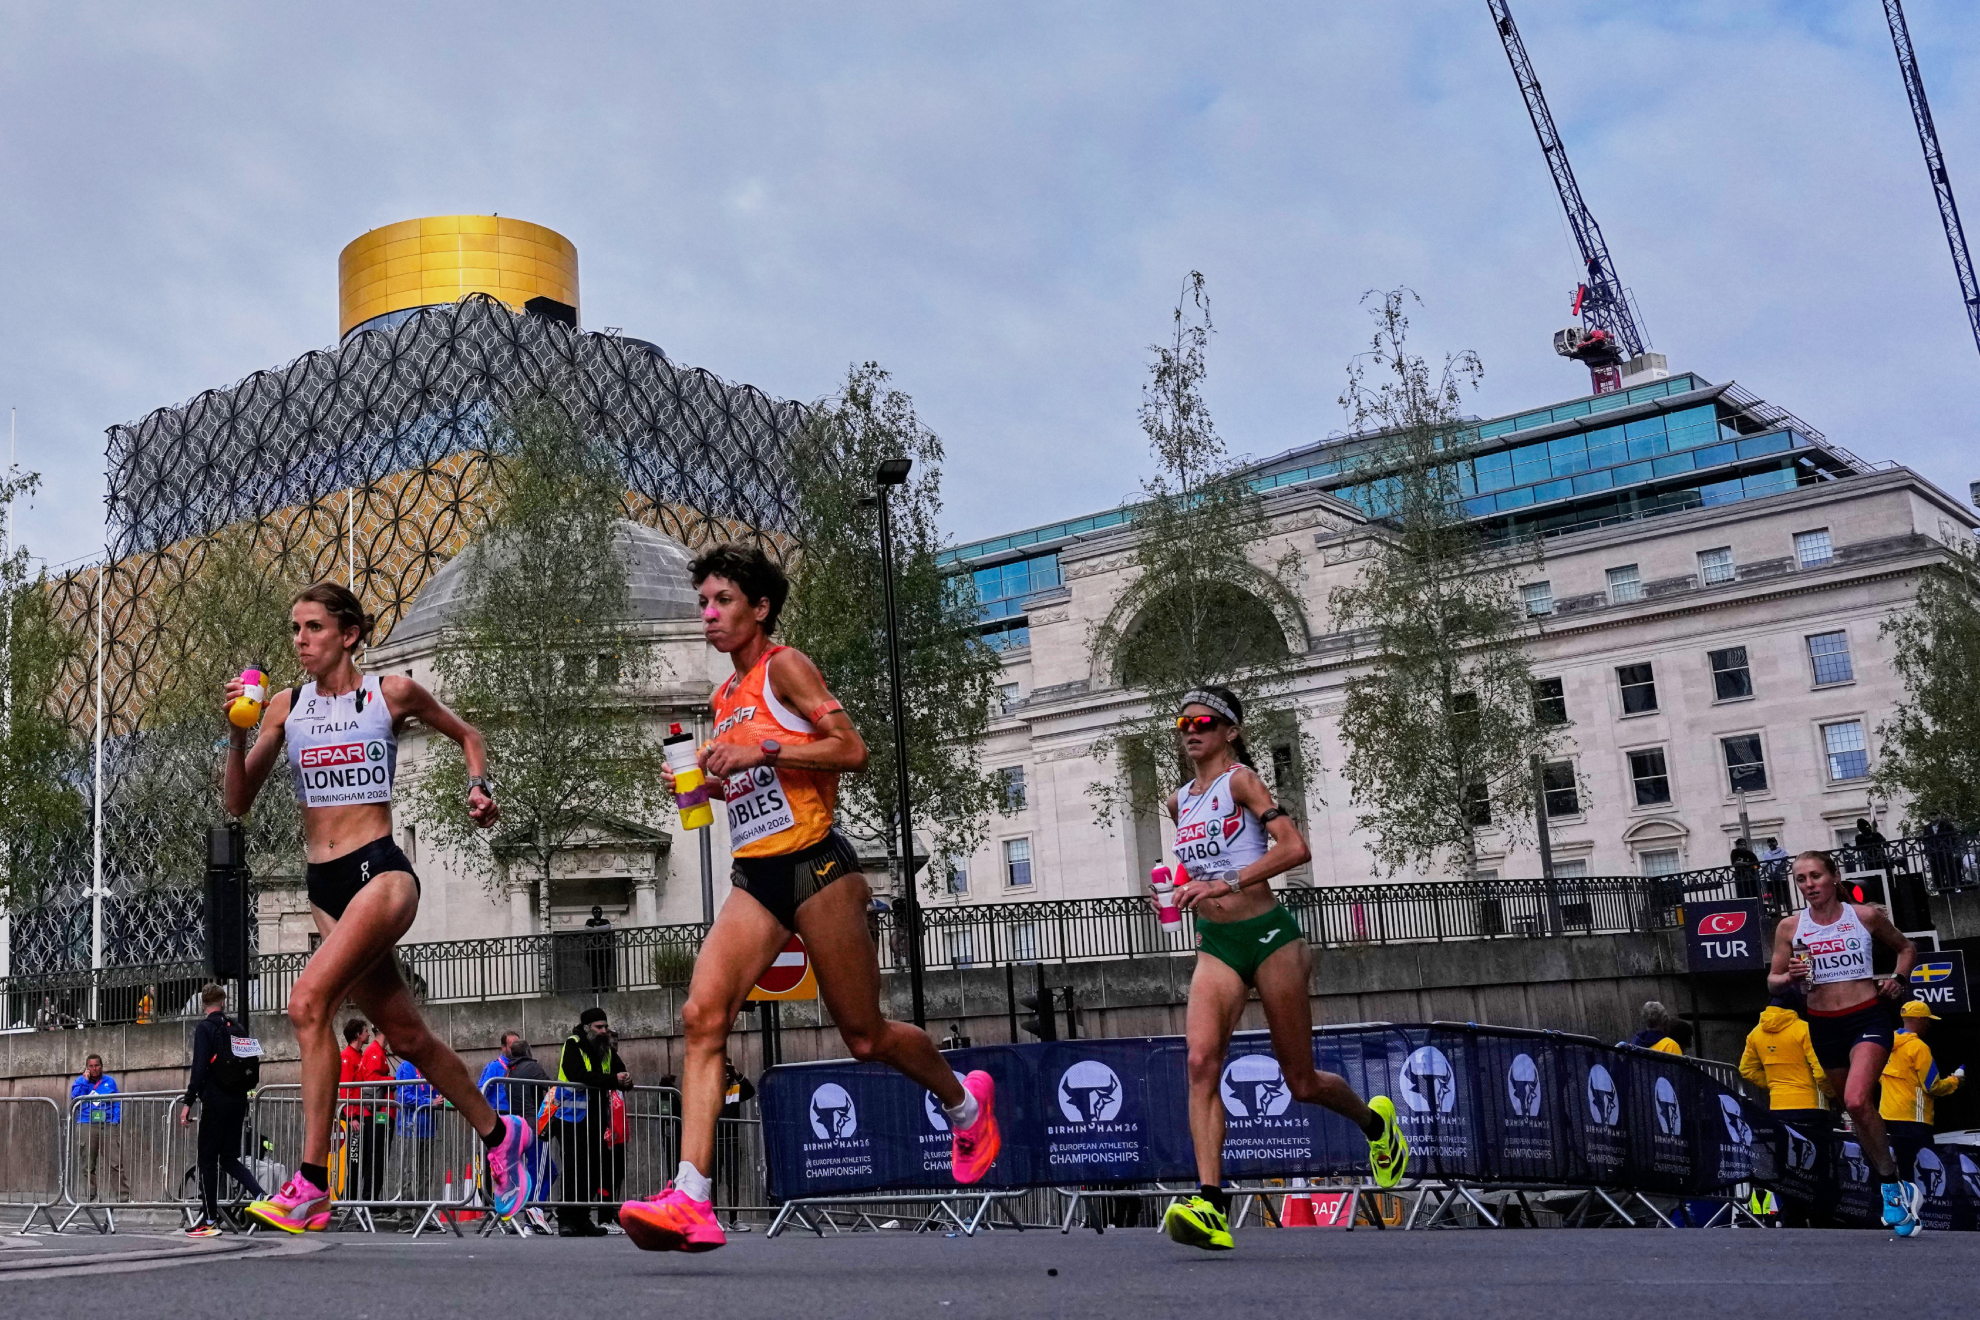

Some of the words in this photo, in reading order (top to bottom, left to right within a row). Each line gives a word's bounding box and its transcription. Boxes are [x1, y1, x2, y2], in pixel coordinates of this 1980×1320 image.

[311, 720, 359, 735] ITALIA
[303, 745, 364, 766] SPAR
[304, 765, 386, 790] LONEDO
[722, 773, 753, 798] PAR
[310, 791, 366, 803] BIRMINGHAM
[367, 789, 388, 799] 2026
[728, 789, 784, 832] OBLES
[766, 814, 791, 831] 2026
[1212, 859, 1231, 869] 2026
[1700, 940, 1750, 959] TUR
[1810, 940, 1845, 954] PAR
[1815, 970, 1850, 979] MINGHAM
[1913, 986, 1956, 1003] SWE
[1226, 1117, 1310, 1128] MINGHAM26
[1397, 1113, 1467, 1126] IRMINGHAM26
[1060, 1143, 1098, 1151] EUROPEAN
[1099, 1141, 1139, 1149] ATHLETICS
[1223, 1138, 1264, 1146] UROPEAN
[1266, 1137, 1311, 1145] ATHLETICS
[1049, 1151, 1140, 1165] CHAMPIONSHIPS
[1409, 1146, 1468, 1158] AMPIONSHIPS
[812, 1158, 841, 1166] EUROPEAN
[805, 1165, 873, 1178] CHAMPIONSHIPS
[1312, 1201, 1339, 1215] OAD
